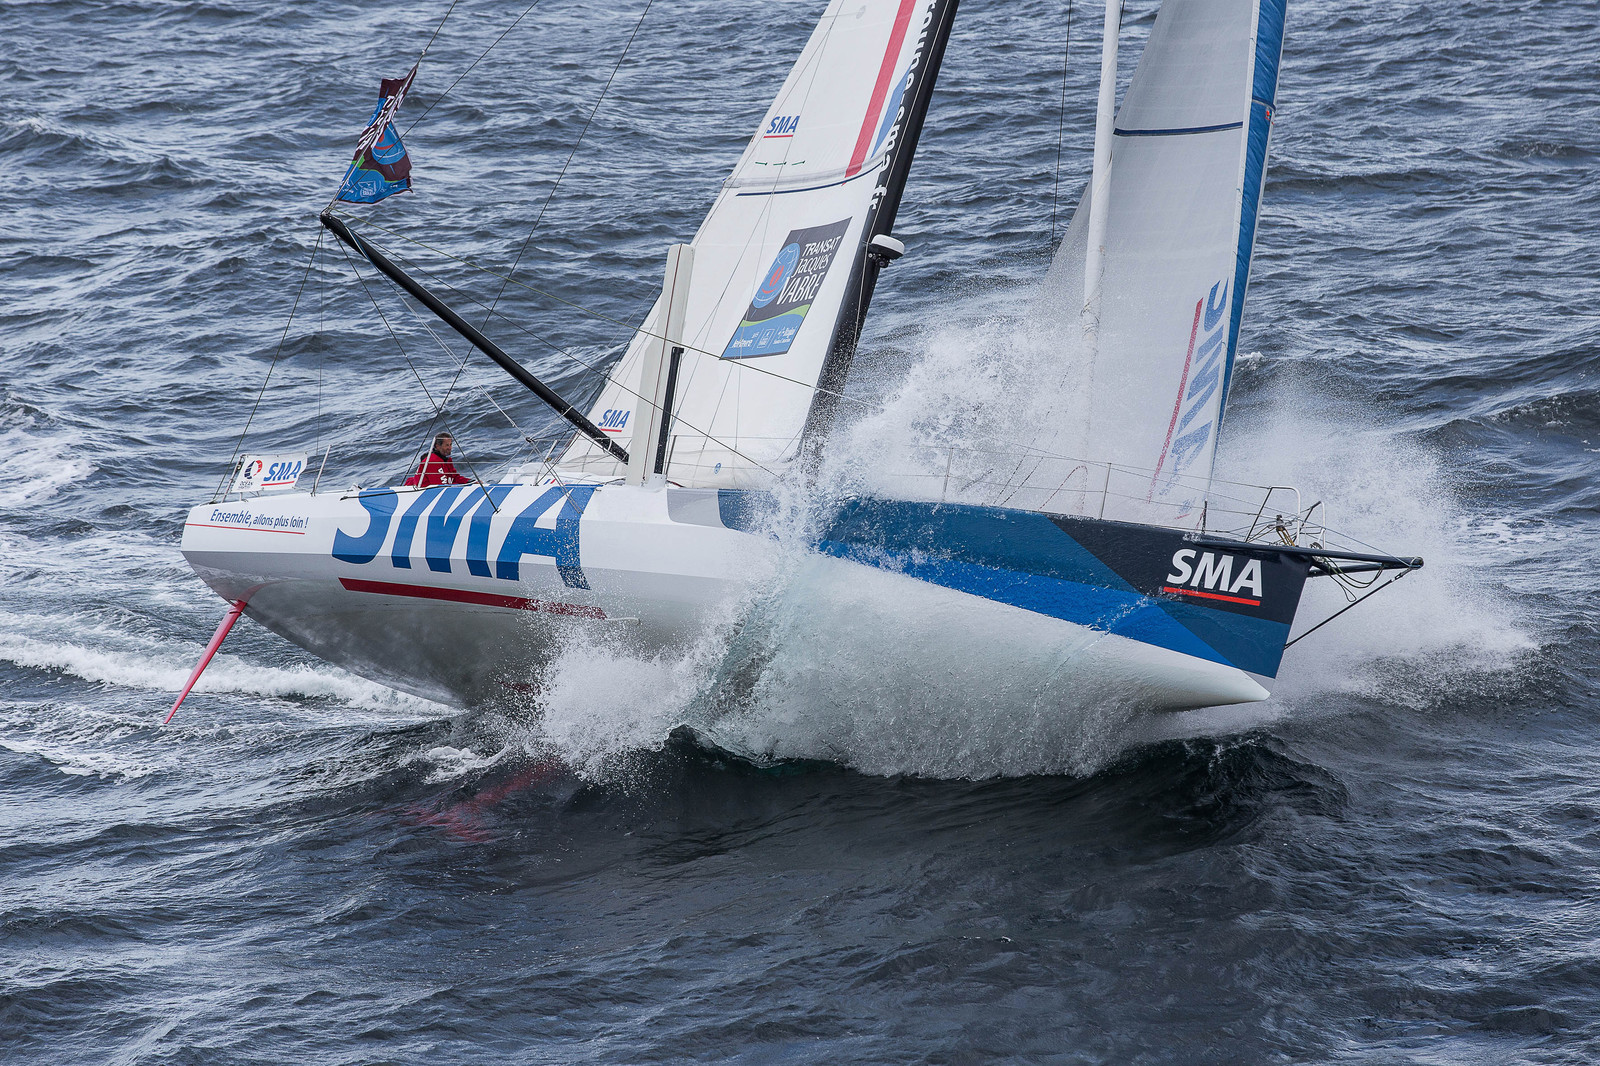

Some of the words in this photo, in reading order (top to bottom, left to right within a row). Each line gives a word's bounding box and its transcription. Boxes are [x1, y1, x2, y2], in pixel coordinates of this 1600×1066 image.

[766, 115, 801, 133] SMA
[801, 235, 841, 257] TRANSAT
[776, 272, 826, 305] VABRE
[598, 408, 631, 429] SMA
[263, 460, 302, 482] SMA
[210, 508, 252, 528] Ensemble,
[253, 513, 274, 526] allons
[273, 515, 290, 529] plus
[289, 515, 304, 528] loin
[332, 485, 596, 590] SMA
[1166, 548, 1263, 598] SMA
